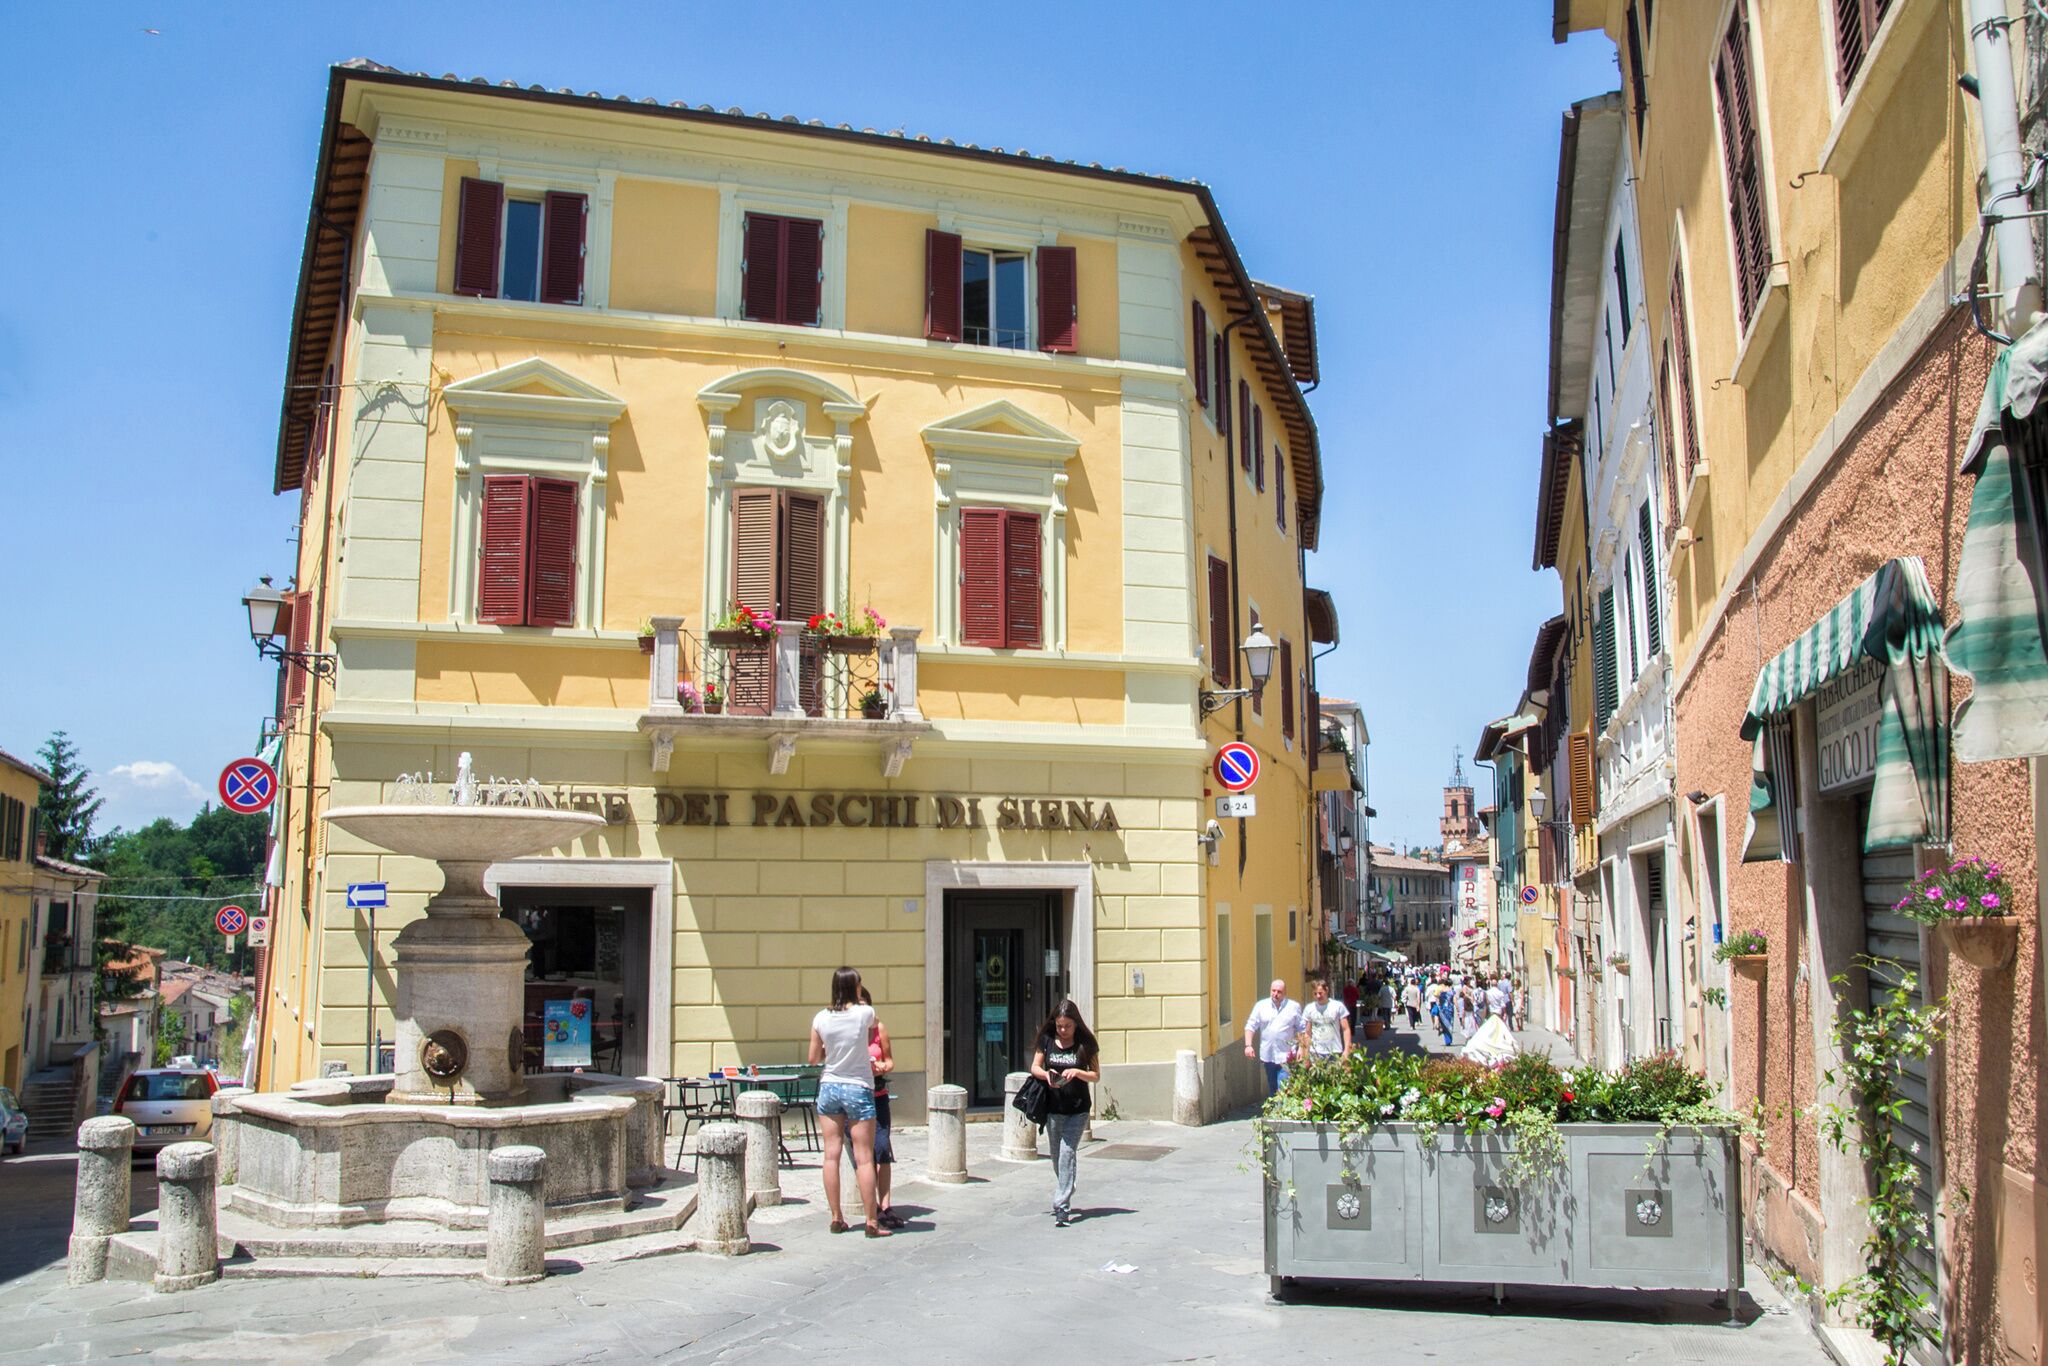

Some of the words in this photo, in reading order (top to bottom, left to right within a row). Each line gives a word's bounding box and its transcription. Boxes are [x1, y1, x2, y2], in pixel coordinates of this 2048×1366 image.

[1820, 731, 1862, 787] GIOCO
[653, 793, 730, 826] DEI
[752, 795, 920, 827] PASCHI
[936, 797, 982, 828] DI
[997, 797, 1122, 831] SIENA
[1464, 866, 1477, 909] BAR
